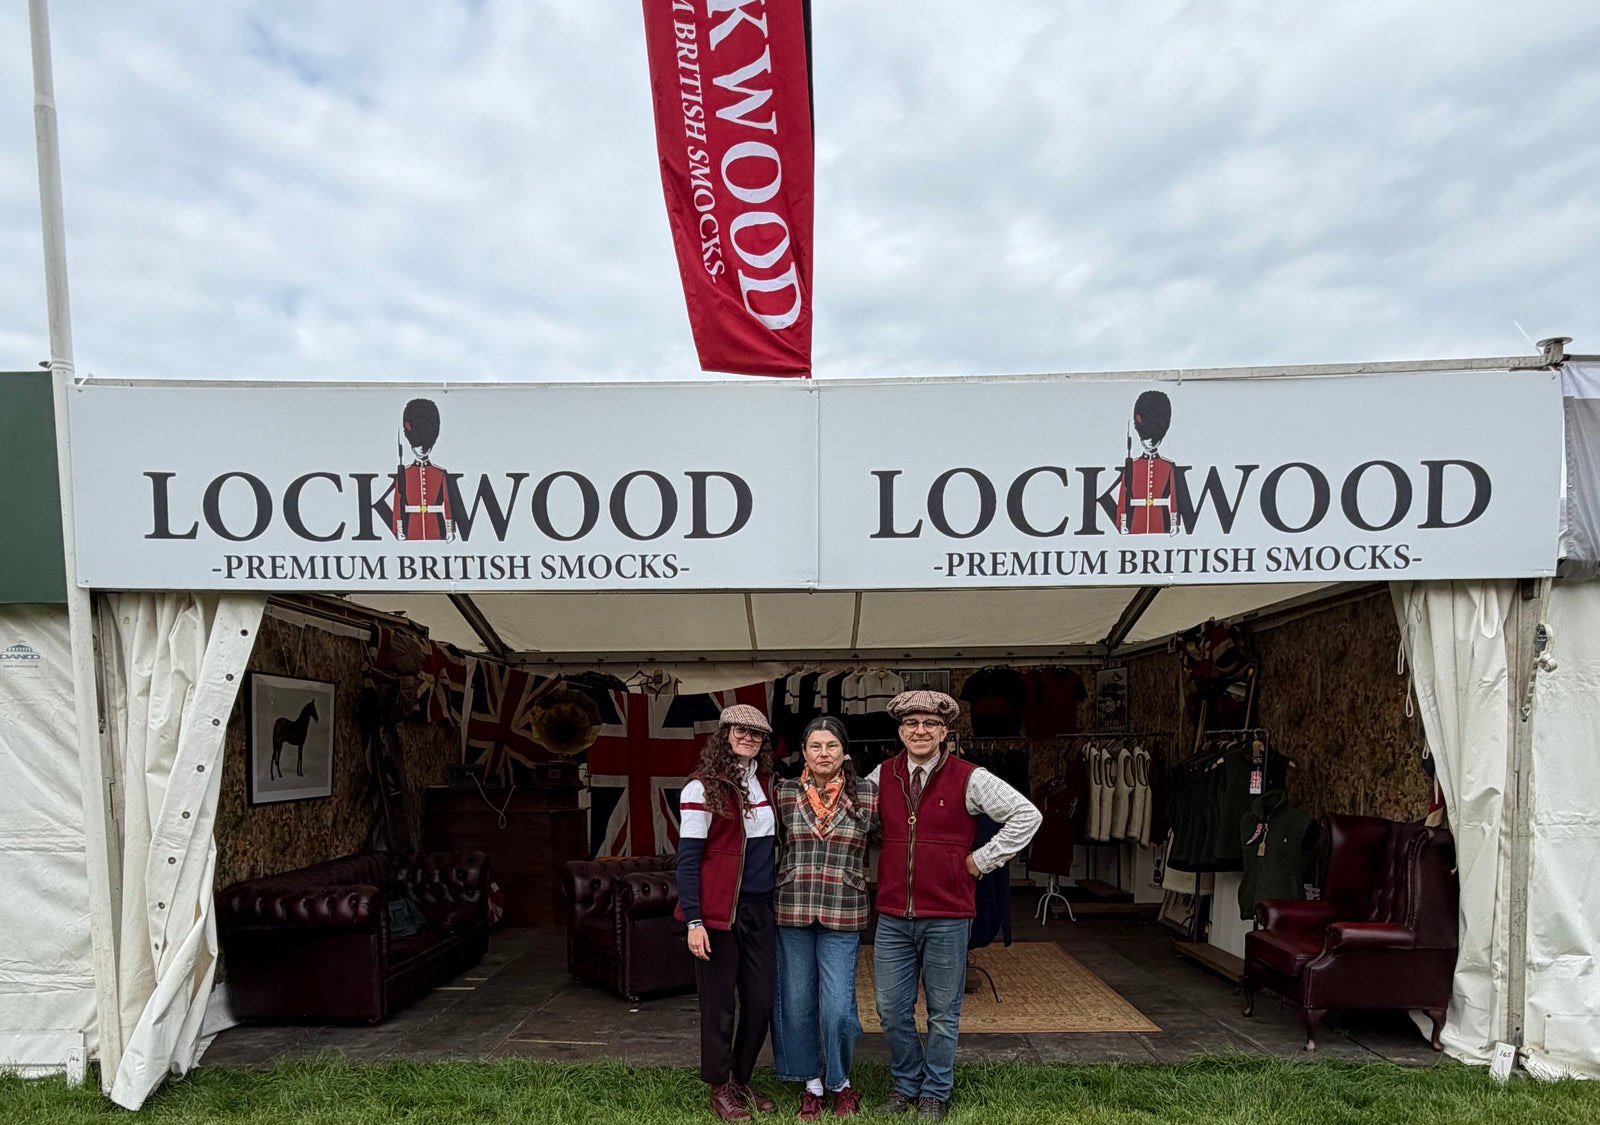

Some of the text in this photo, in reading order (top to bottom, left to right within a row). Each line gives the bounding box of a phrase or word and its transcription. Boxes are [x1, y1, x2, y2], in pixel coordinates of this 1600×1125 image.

[673, 18, 707, 144] BRITISH
[686, 145, 726, 284] SMOCKS-
[143, 469, 753, 543] LOCKWOOD
[870, 460, 1492, 539] LOCKWOOD
[211, 553, 690, 581] -PREMIUM BRITISH SMOCKS-
[933, 544, 1423, 577] -PREMIUM BRITISH SMOCKS-
[1499, 1050, 1513, 1058] 165
